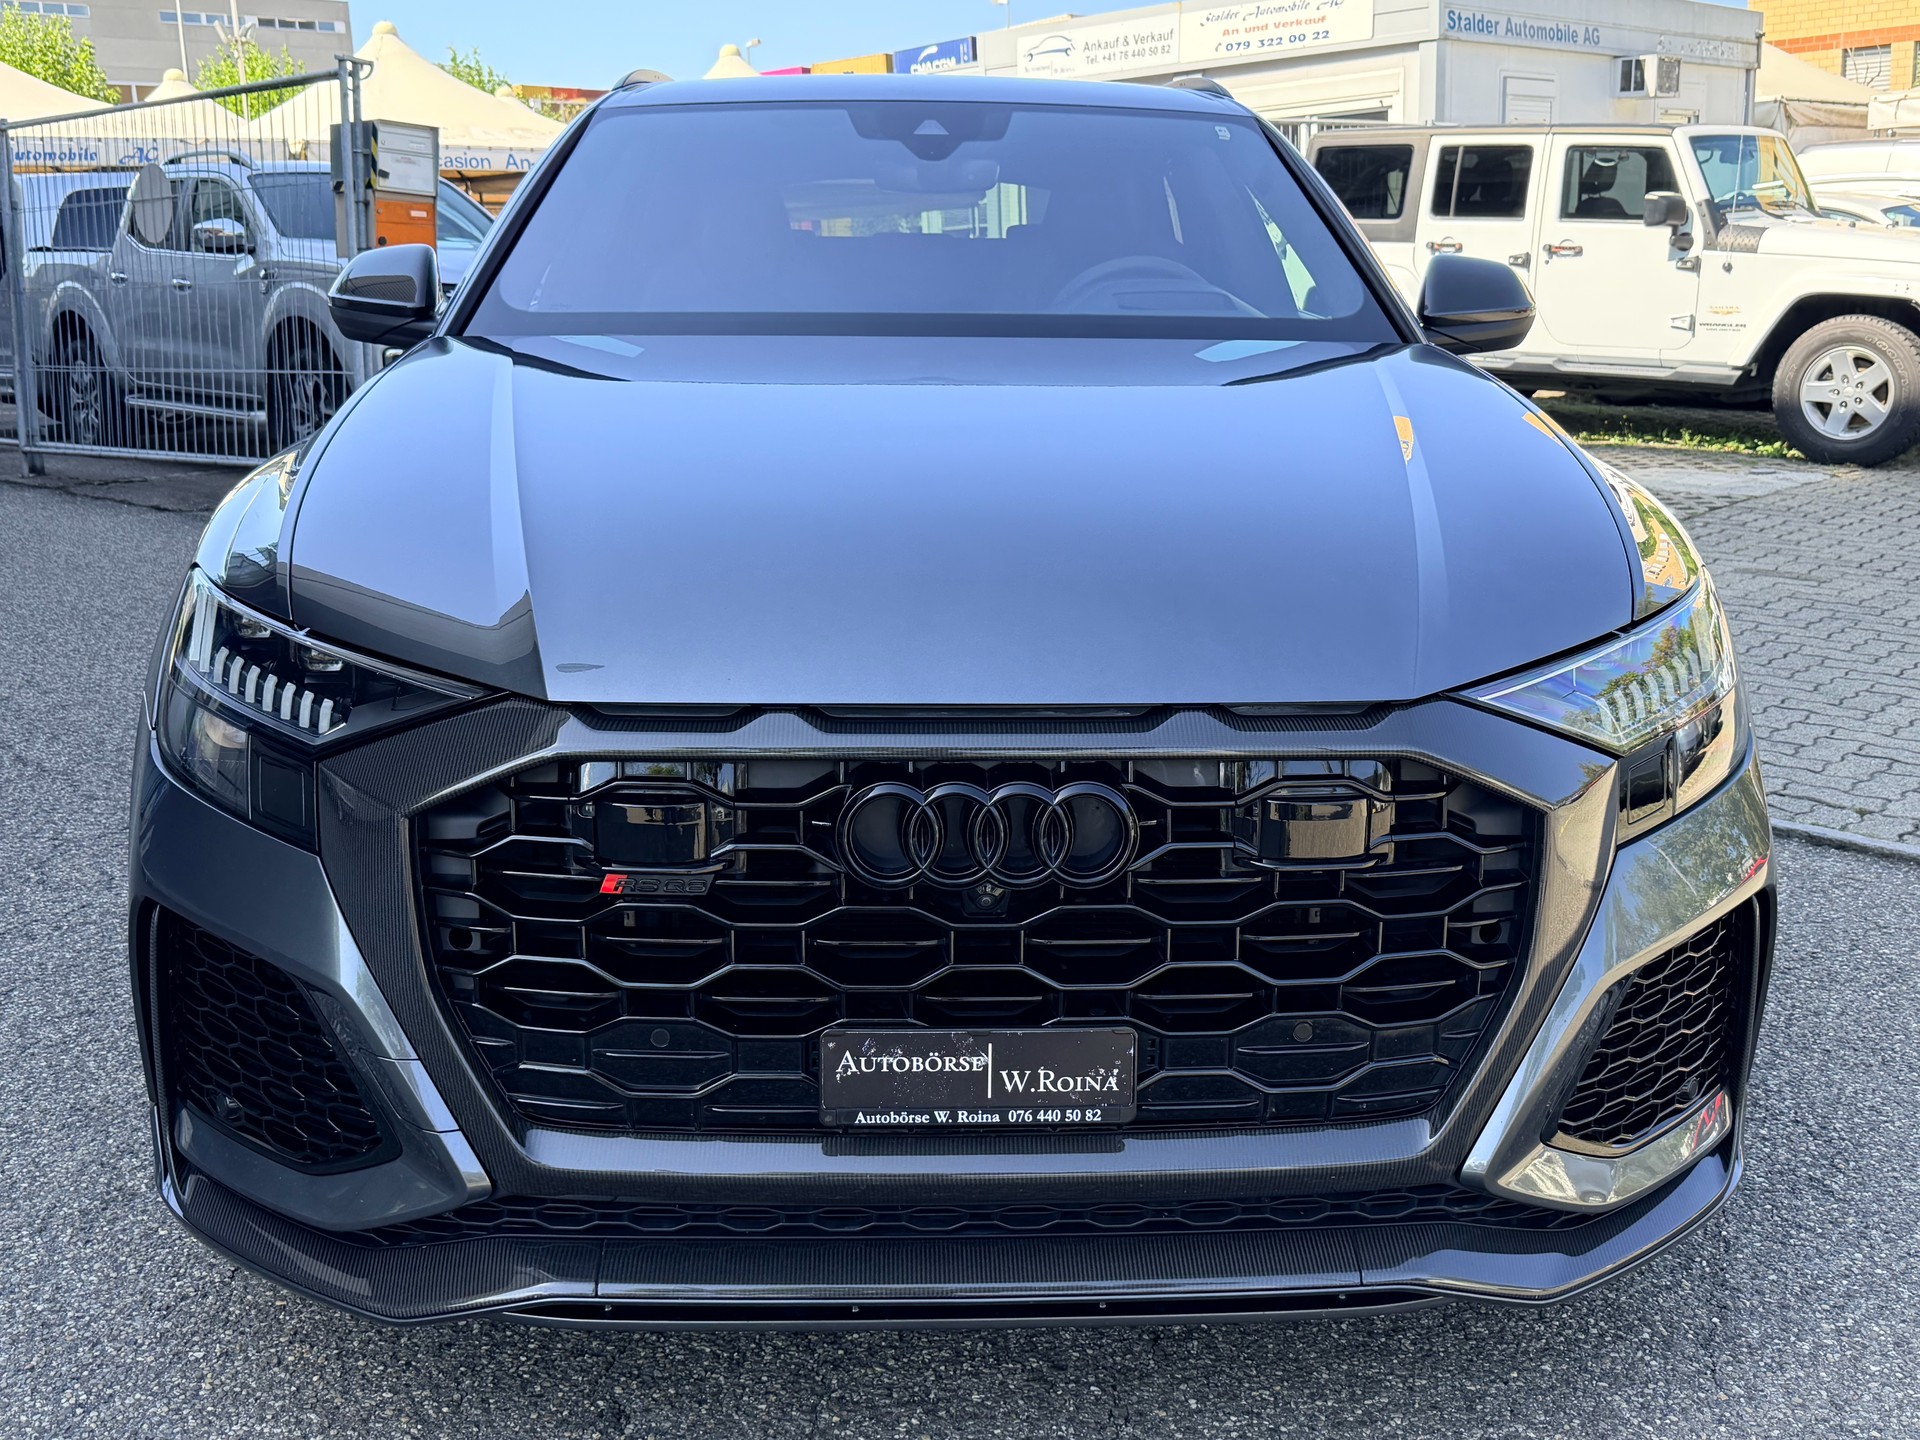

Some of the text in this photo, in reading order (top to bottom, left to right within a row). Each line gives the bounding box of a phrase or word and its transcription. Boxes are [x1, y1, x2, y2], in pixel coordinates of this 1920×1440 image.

[1200, 10, 1240, 27] Stalder
[1243, 1, 1310, 21] Automobile
[1222, 15, 1327, 37] An und Verkauf
[1447, 10, 1600, 45] Stalder Automobile AG
[1083, 28, 1174, 53] Ankauf & Verkauf
[1225, 30, 1330, 52] 079 322 00 22
[1086, 44, 1171, 65] Tel. +41 76 440 50 82
[11, 147, 97, 161] utomobile
[855, 1109, 1102, 1124] Autobörse W. Roina 076 440 50 82
